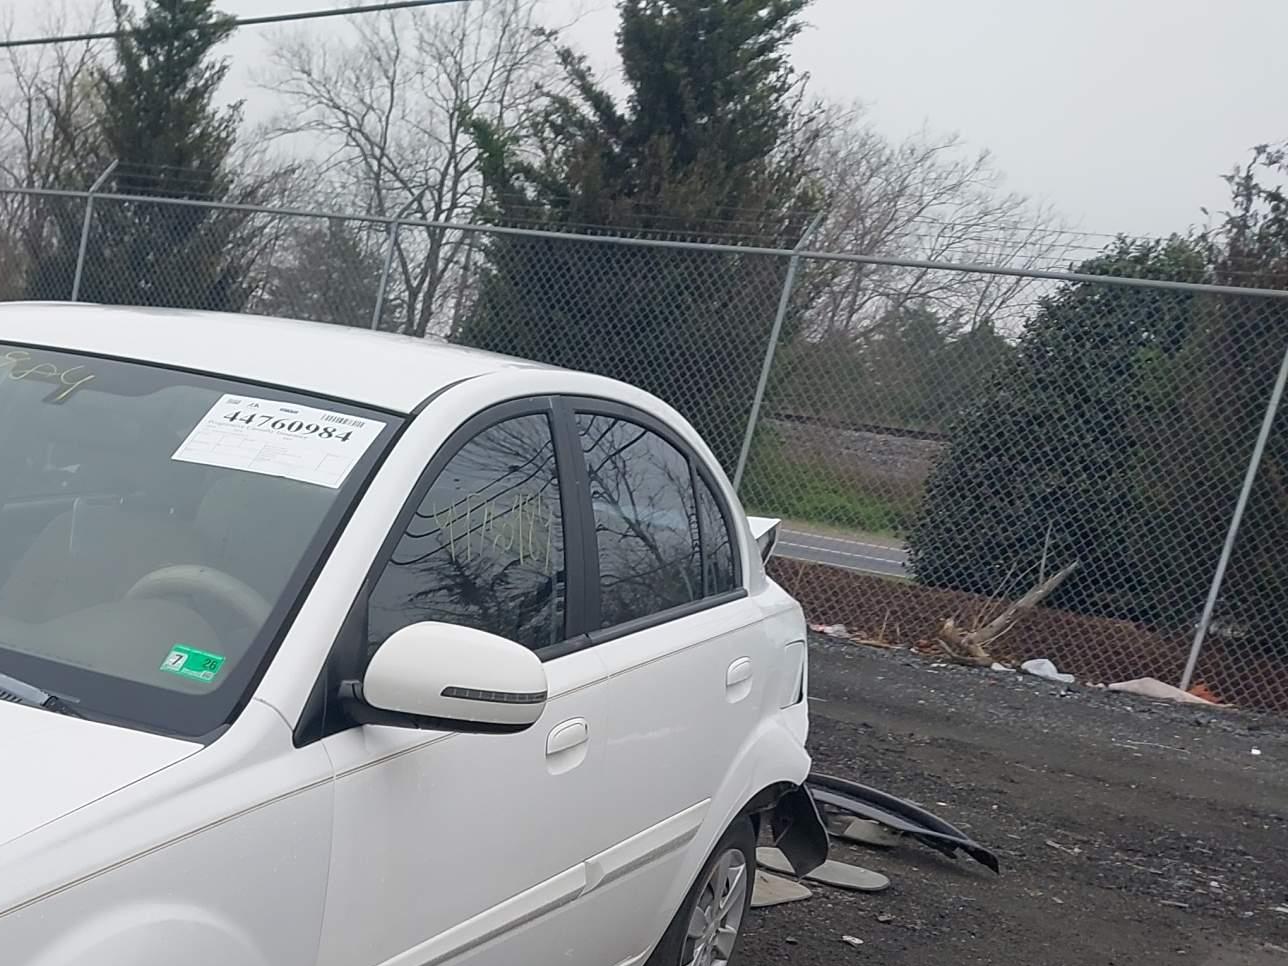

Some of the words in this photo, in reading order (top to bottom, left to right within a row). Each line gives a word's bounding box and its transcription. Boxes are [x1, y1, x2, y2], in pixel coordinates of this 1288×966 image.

[223, 410, 353, 442] 44760984
[171, 654, 183, 666] 7
[201, 658, 218, 671] 26
